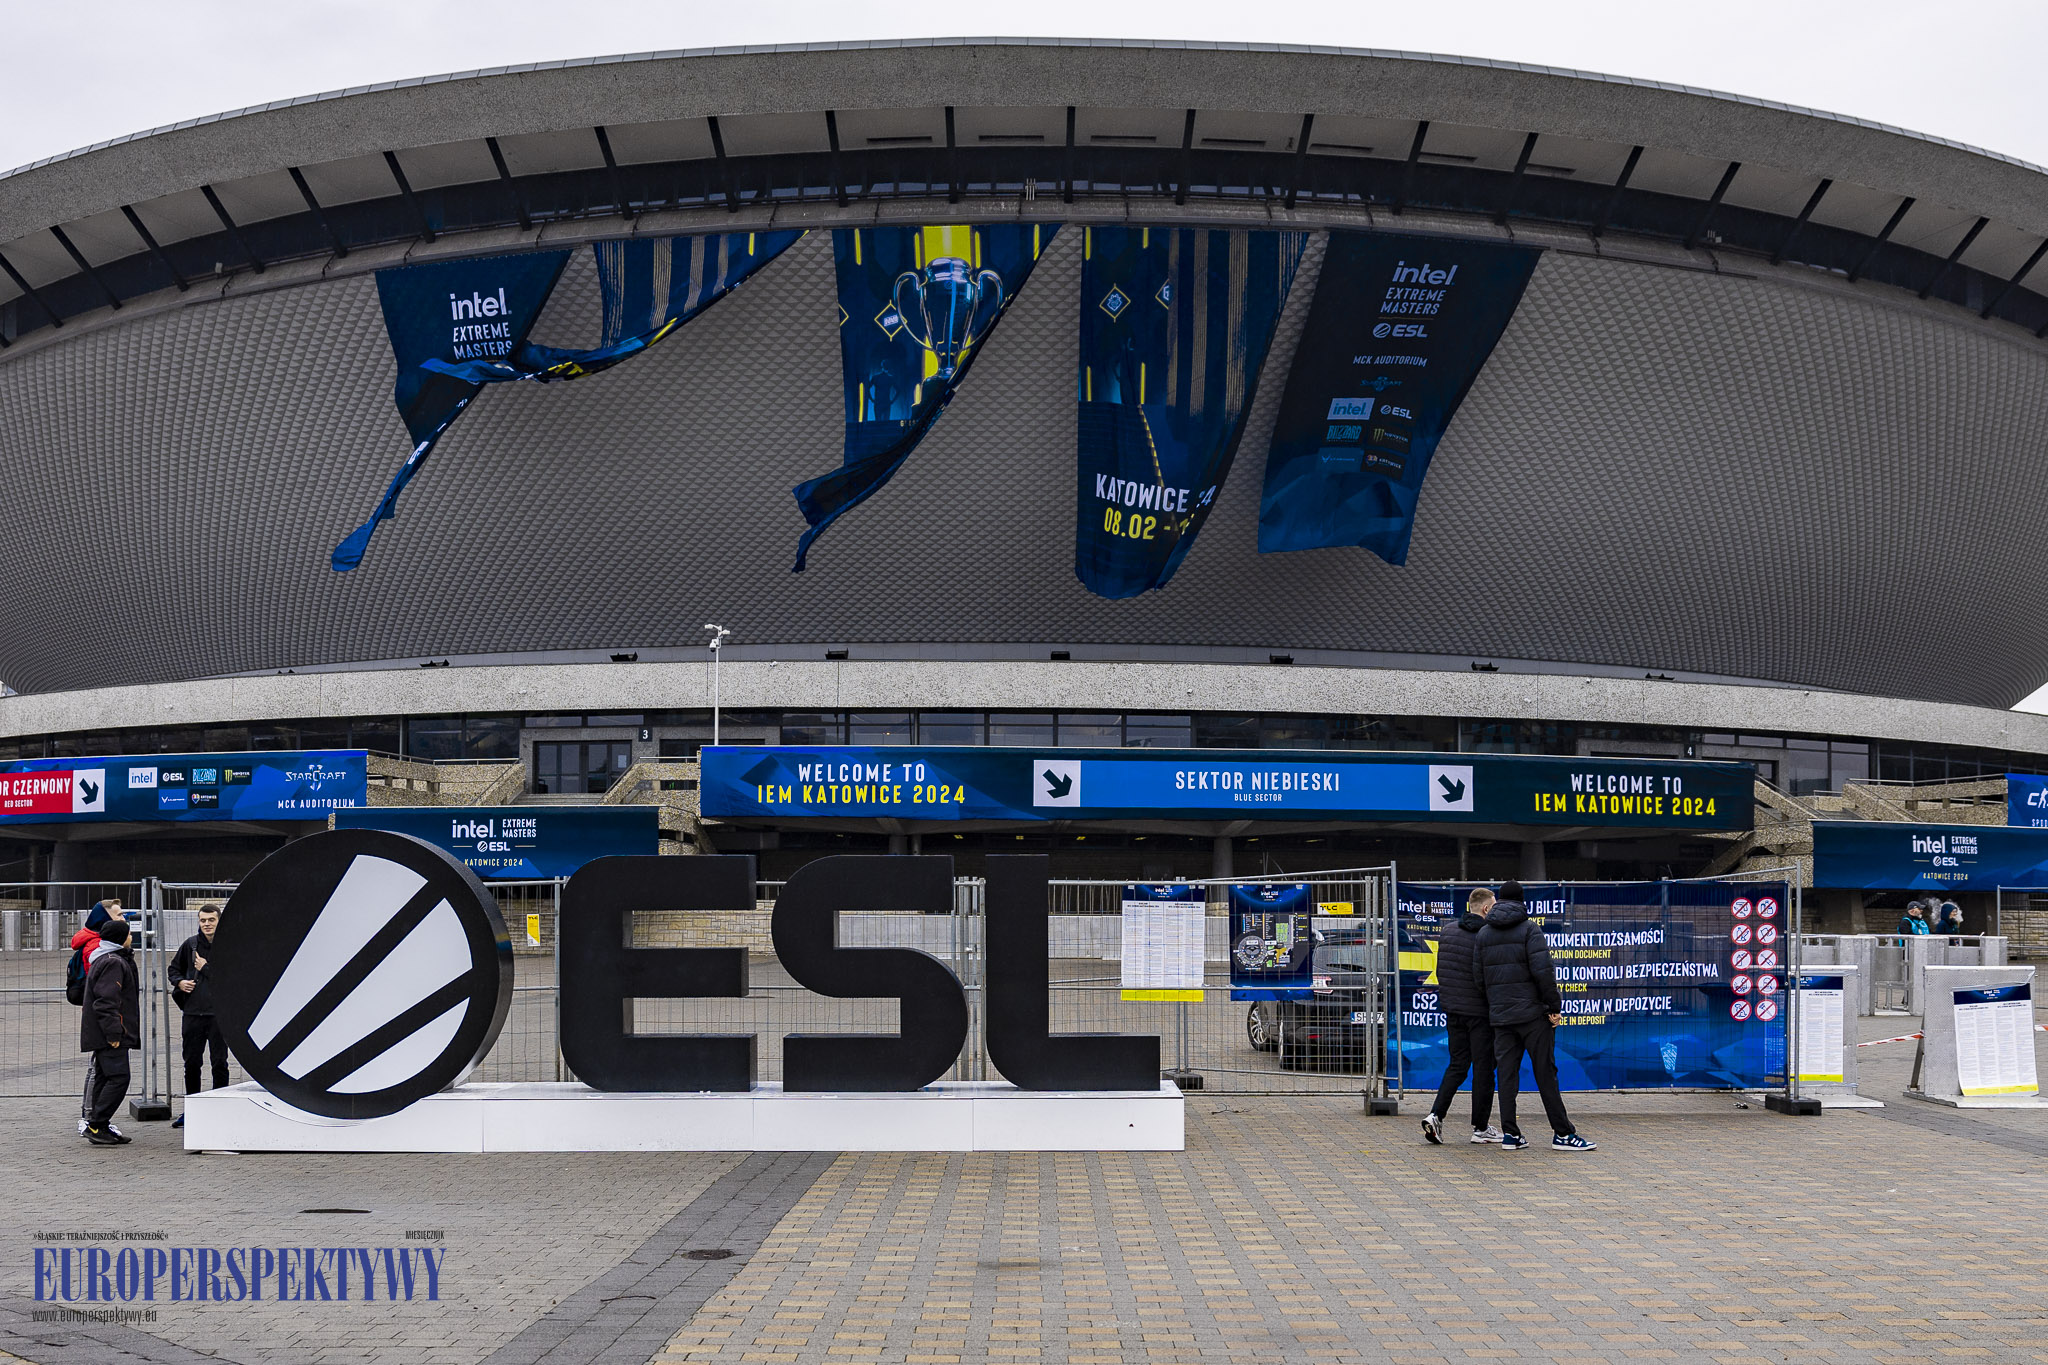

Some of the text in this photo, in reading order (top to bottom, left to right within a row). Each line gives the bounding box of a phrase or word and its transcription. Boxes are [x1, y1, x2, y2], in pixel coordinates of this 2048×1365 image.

[1392, 261, 1458, 285] intel
[1385, 287, 1447, 301] EXTREME
[450, 287, 507, 320] intel
[1380, 301, 1440, 315] MASTERS
[453, 322, 511, 343] EXTREME
[1392, 324, 1428, 338] ESL
[453, 340, 512, 360] MASTERS
[1353, 355, 1428, 368] MCK AUDITORIUM
[1332, 402, 1367, 416] intel
[1391, 406, 1412, 419] ESL
[1326, 425, 1362, 440] BLIZZARD
[1095, 472, 1190, 513] KATOWICE
[1104, 506, 1157, 540] 08.02
[642, 729, 649, 740] 3
[1687, 746, 1693, 756] 4
[131, 771, 153, 784] intel
[170, 772, 184, 781] ESL
[192, 768, 217, 782] BLIZZARD
[798, 763, 926, 783] WELCOME TO
[13, 778, 71, 796] CZERWONY
[1175, 770, 1340, 792] SEKTOR NIEBIESKI
[1570, 773, 1682, 795] WELCOME TO
[757, 784, 966, 804] IEM KATOWICE 2024
[1234, 793, 1283, 802] BLUE SECTOR
[4, 799, 33, 808] RED SECTOR
[277, 798, 355, 809] MCK AUDITORIUM
[1534, 793, 1716, 816] IEM KATOWICE 2024
[452, 818, 494, 838] intel
[502, 818, 537, 828] EXTREME
[502, 828, 537, 838] MASTERS
[489, 841, 511, 852] ESL
[1912, 834, 1946, 854] intel
[1951, 835, 1978, 846] EXTREME
[1951, 845, 1978, 855] MASTERS
[464, 858, 523, 867] KATOWICE 2024
[1942, 856, 1959, 867] ESL
[1923, 872, 1969, 881] KATOWICE 2024
[1398, 898, 1426, 913] intel
[1430, 901, 1454, 909] EXTREME
[1536, 899, 1566, 915] BILET
[1406, 923, 1430, 932] KATOWICE
[1544, 928, 1664, 948] OKUMENT TOŻSAMOŚCI
[1575, 949, 1612, 959] DOCUMENT
[559, 853, 1160, 1093] ESL
[1555, 966, 1569, 981] DO
[1625, 960, 1719, 979] BEZPIECZEŃSTWA
[1565, 983, 1588, 992] CHECK
[1412, 992, 1438, 1010] CS2
[1560, 995, 1672, 1014] ZOSTAW W DEPOZYCIE
[1402, 1011, 1447, 1027] TICKETS
[1569, 1016, 1577, 1025] IN
[1578, 1015, 1606, 1025] DEPOSIT
